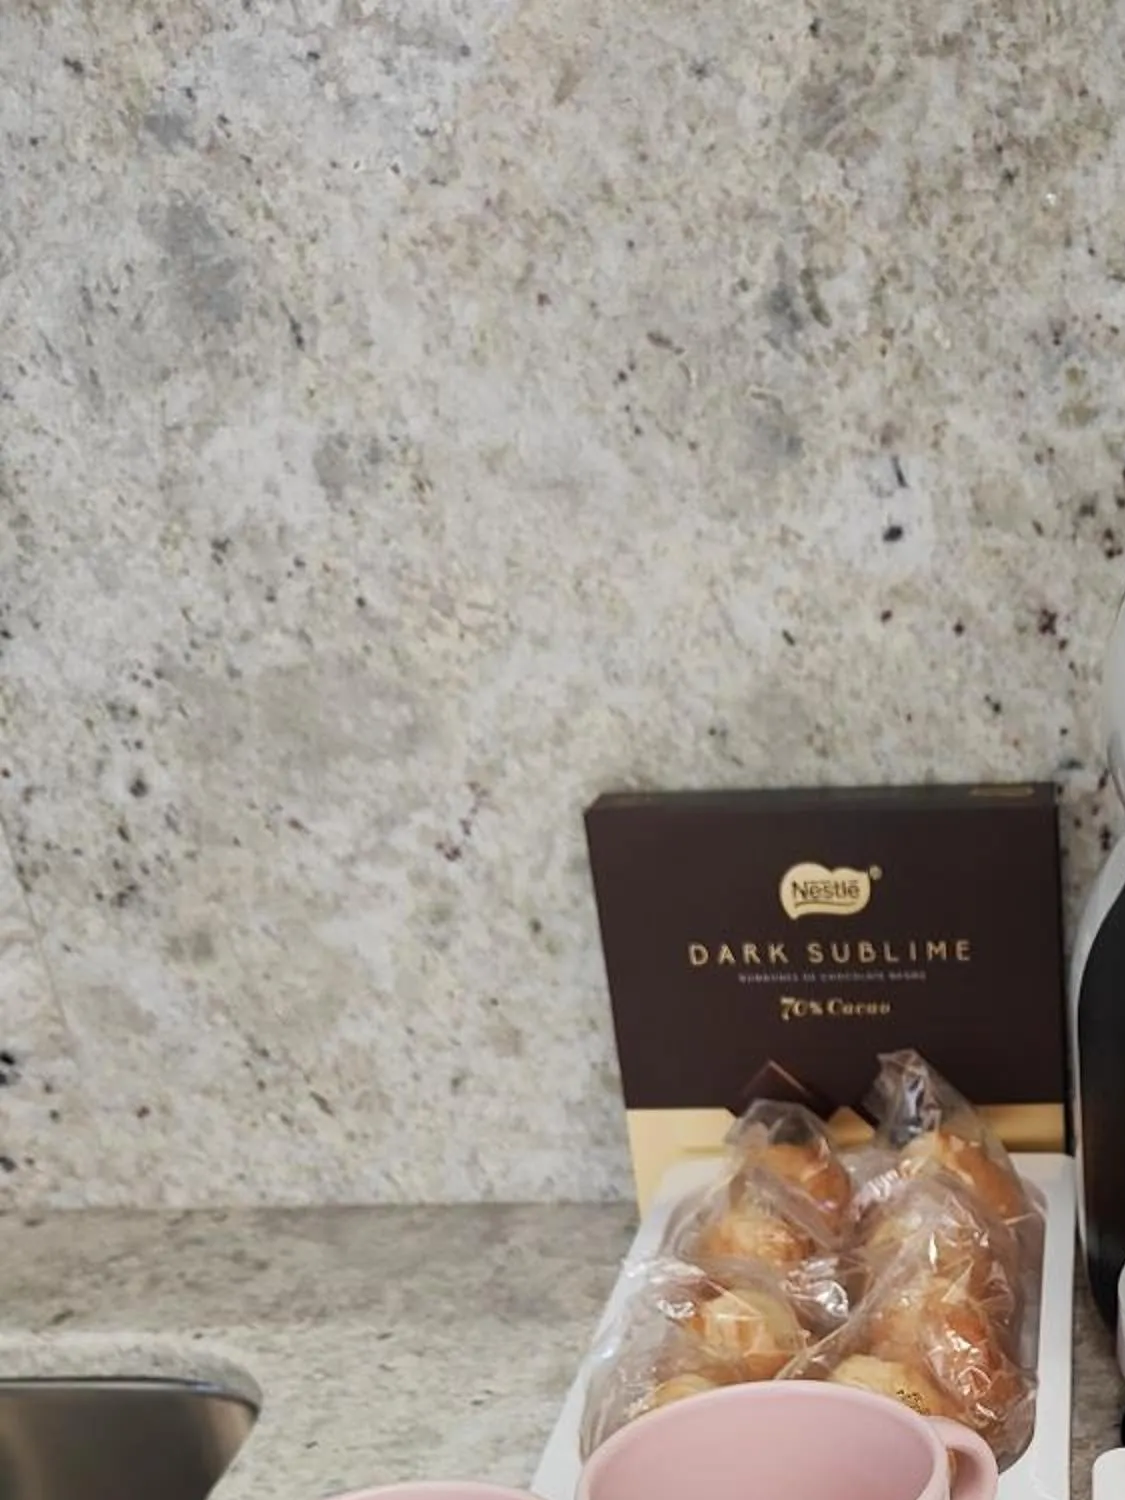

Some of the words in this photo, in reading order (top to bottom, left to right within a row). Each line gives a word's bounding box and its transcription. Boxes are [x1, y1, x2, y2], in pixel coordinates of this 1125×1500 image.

[688, 942, 789, 966] DARK
[807, 940, 971, 963] SUBLIME
[780, 996, 823, 1020] 70%
[827, 997, 891, 1015] Cacao
